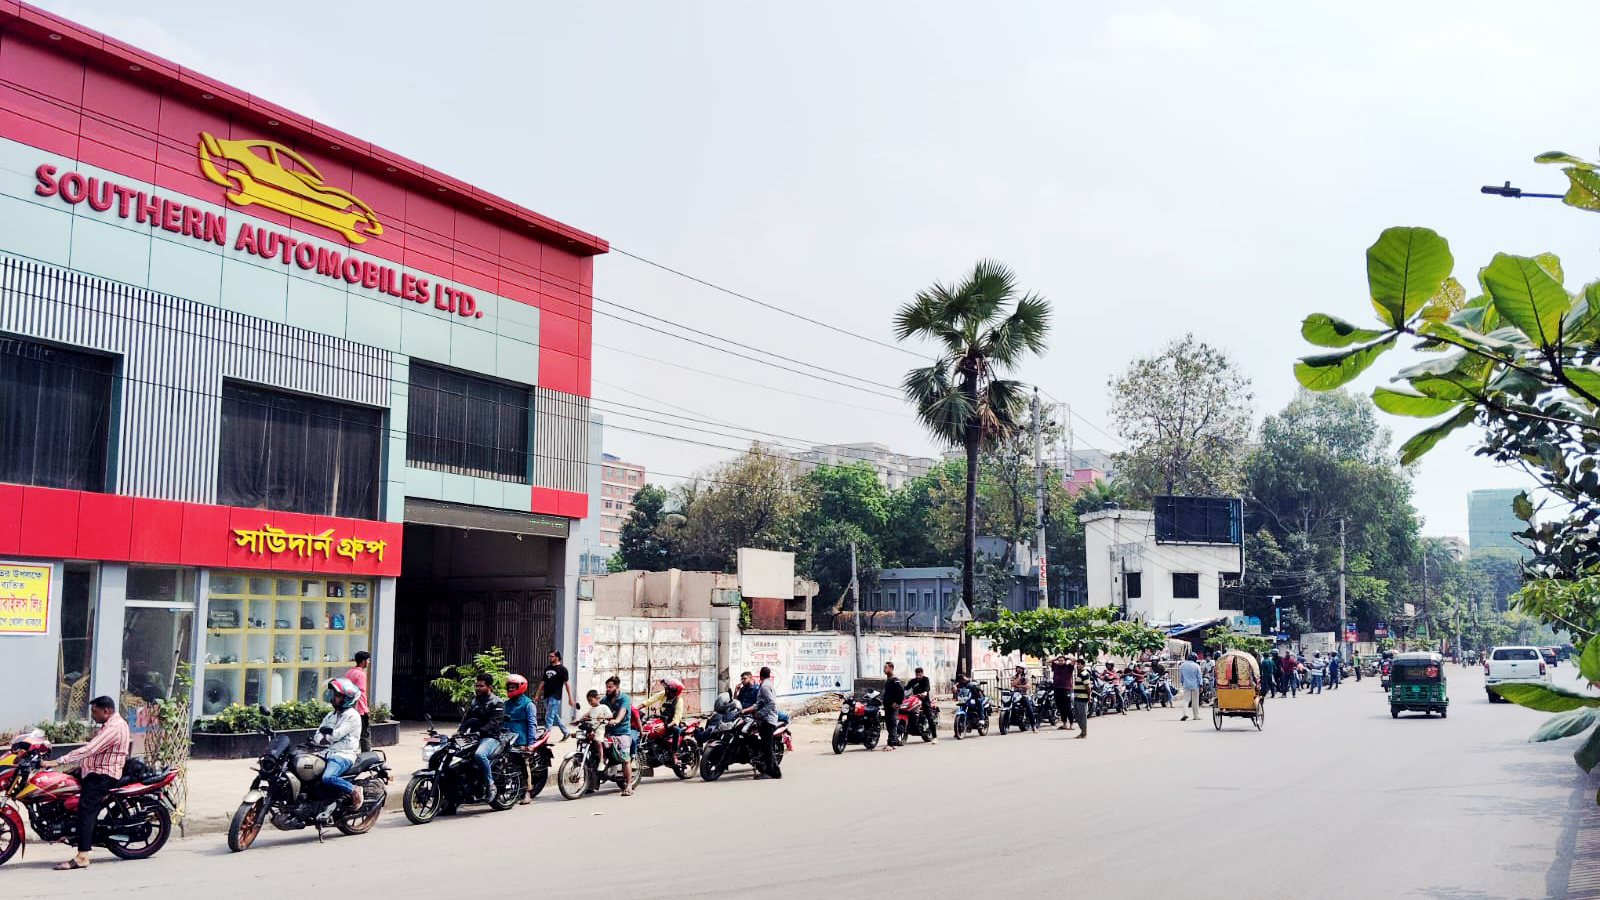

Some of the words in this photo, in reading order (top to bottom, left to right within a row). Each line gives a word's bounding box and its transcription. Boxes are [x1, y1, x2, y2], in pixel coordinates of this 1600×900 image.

[35, 163, 227, 246] SOUTHERN
[235, 223, 430, 303] AUTOMOBILES
[435, 283, 483, 319] LTD.
[233, 523, 336, 560] সাউদার্ন
[336, 535, 388, 562] গ্রুপ
[0, 594, 28, 613] বাইলস
[805, 675, 819, 689] 444
